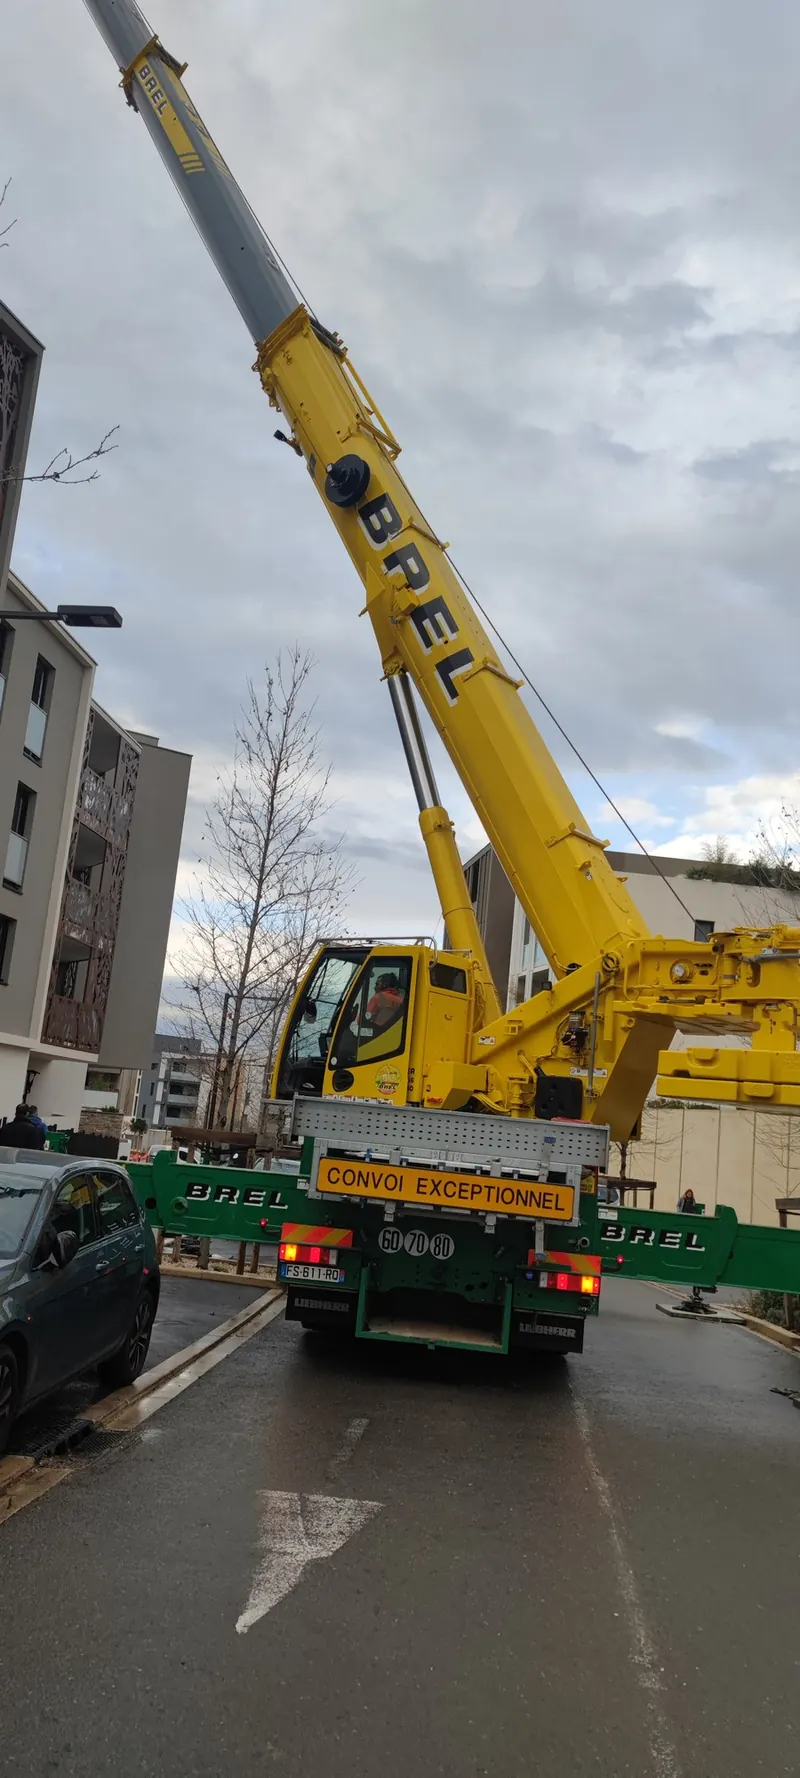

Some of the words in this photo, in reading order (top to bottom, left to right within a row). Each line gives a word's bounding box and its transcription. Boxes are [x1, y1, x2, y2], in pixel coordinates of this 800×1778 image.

[138, 64, 168, 117] BREL
[356, 492, 475, 707] BREL
[185, 1182, 288, 1209] BREL
[327, 1167, 404, 1192] CONVOI
[416, 1177, 565, 1212] EXCEPTIONNEL
[382, 1229, 400, 1251] 60
[408, 1232, 426, 1254] 70
[433, 1236, 451, 1257] 80
[600, 1222, 706, 1252] BREL
